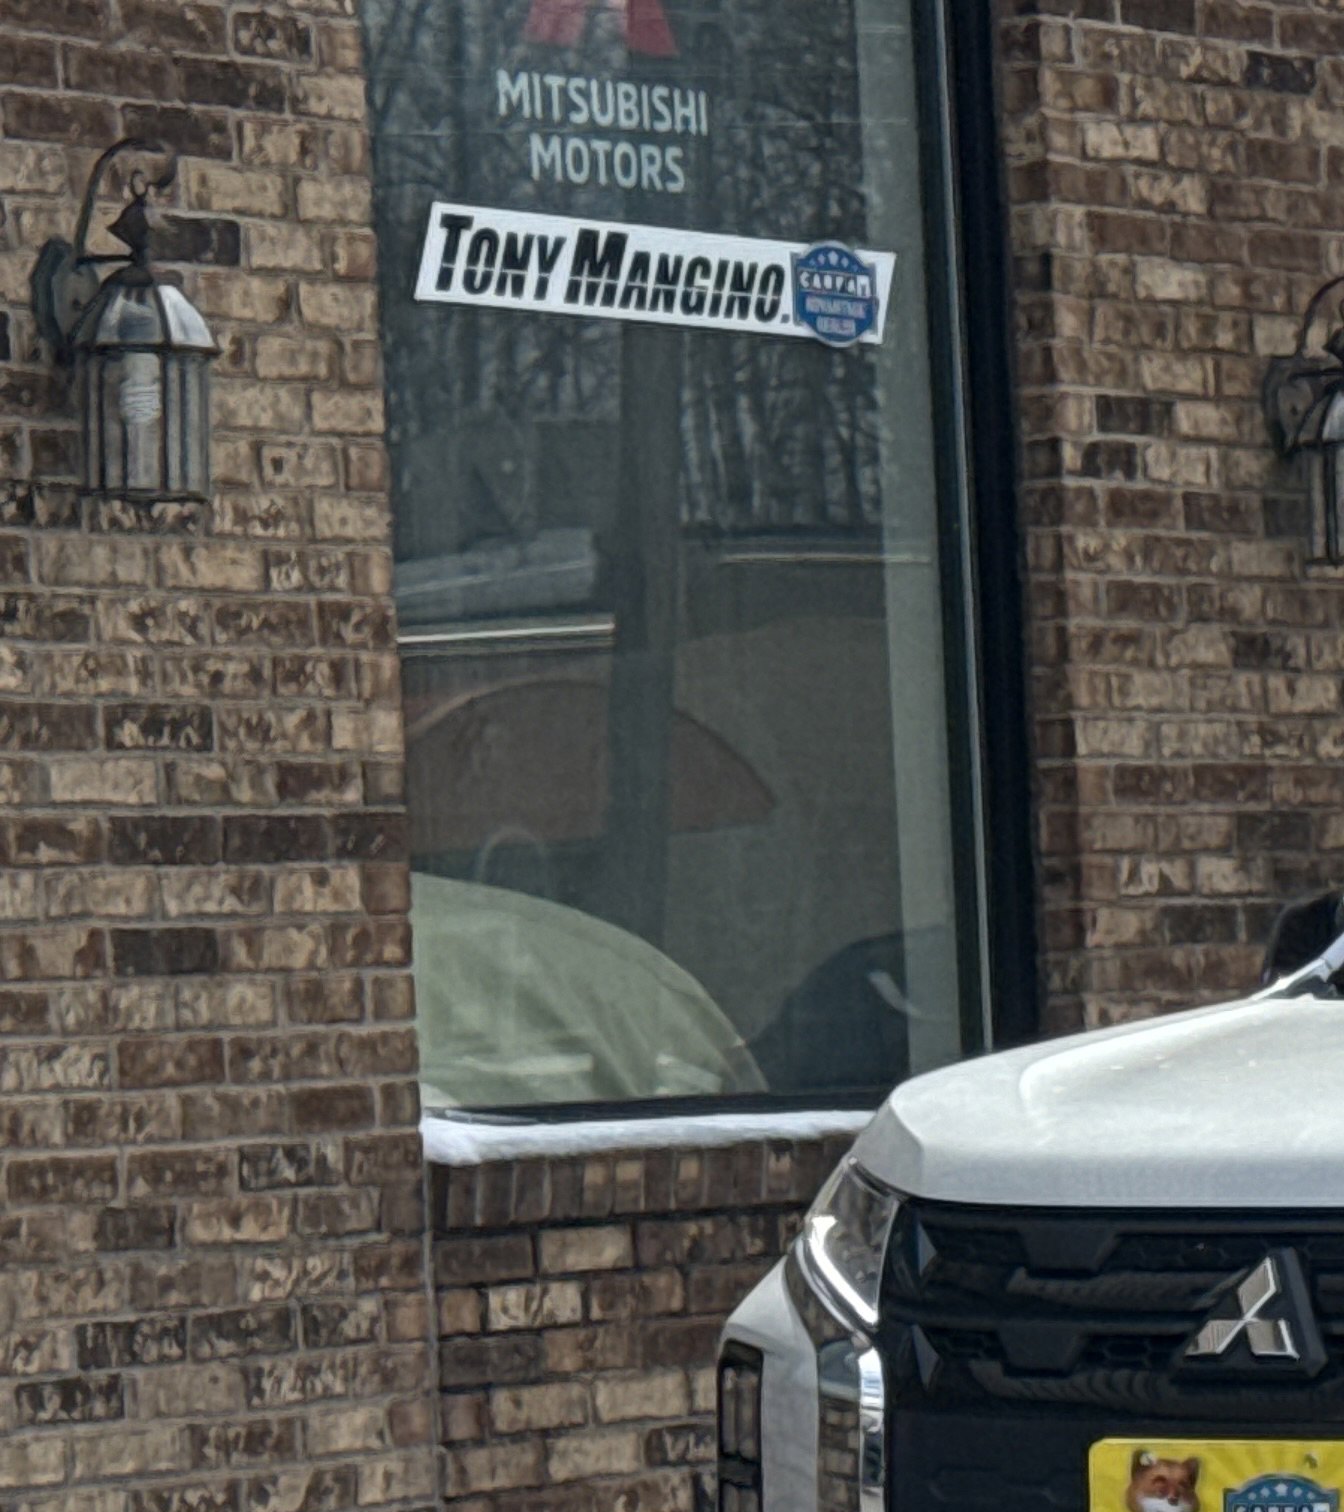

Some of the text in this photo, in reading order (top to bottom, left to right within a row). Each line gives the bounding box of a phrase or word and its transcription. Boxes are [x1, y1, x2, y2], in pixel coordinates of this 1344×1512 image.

[496, 69, 708, 137] MITSUBISHI
[529, 133, 686, 193] MOTORS
[435, 213, 567, 301] TONY
